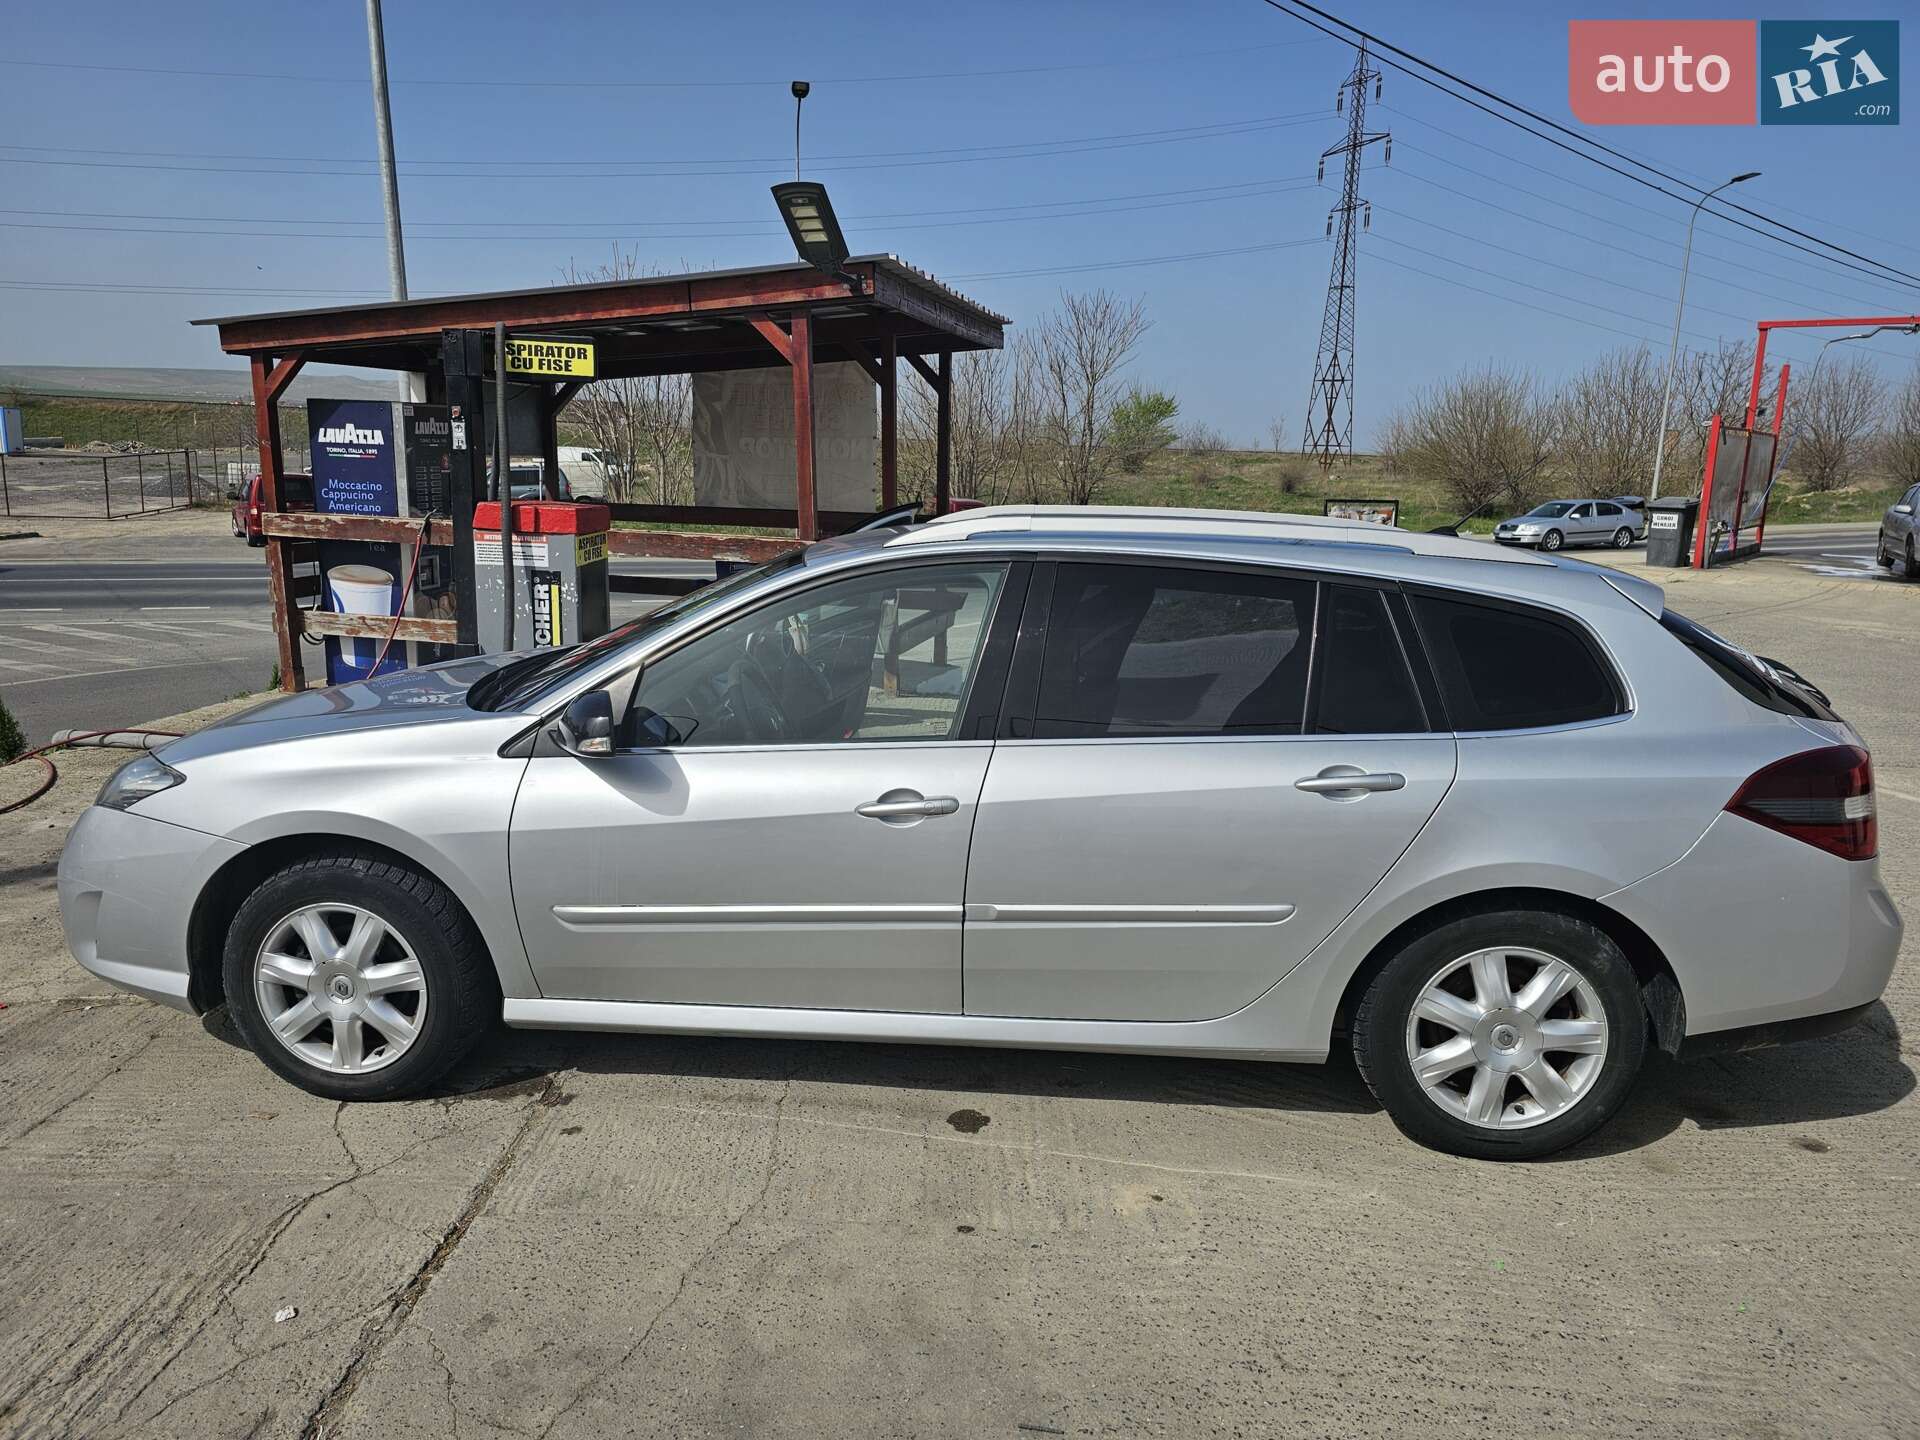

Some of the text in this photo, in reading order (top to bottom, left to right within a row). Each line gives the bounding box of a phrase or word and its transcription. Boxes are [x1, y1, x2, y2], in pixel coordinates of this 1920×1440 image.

[505, 342, 588, 360] SPIRATOR
[511, 356, 573, 372] CU FISE
[318, 423, 385, 445] LAVAZZA
[328, 479, 383, 491] Moccacino
[321, 488, 374, 501] Cappucino
[328, 500, 382, 512] Americano
